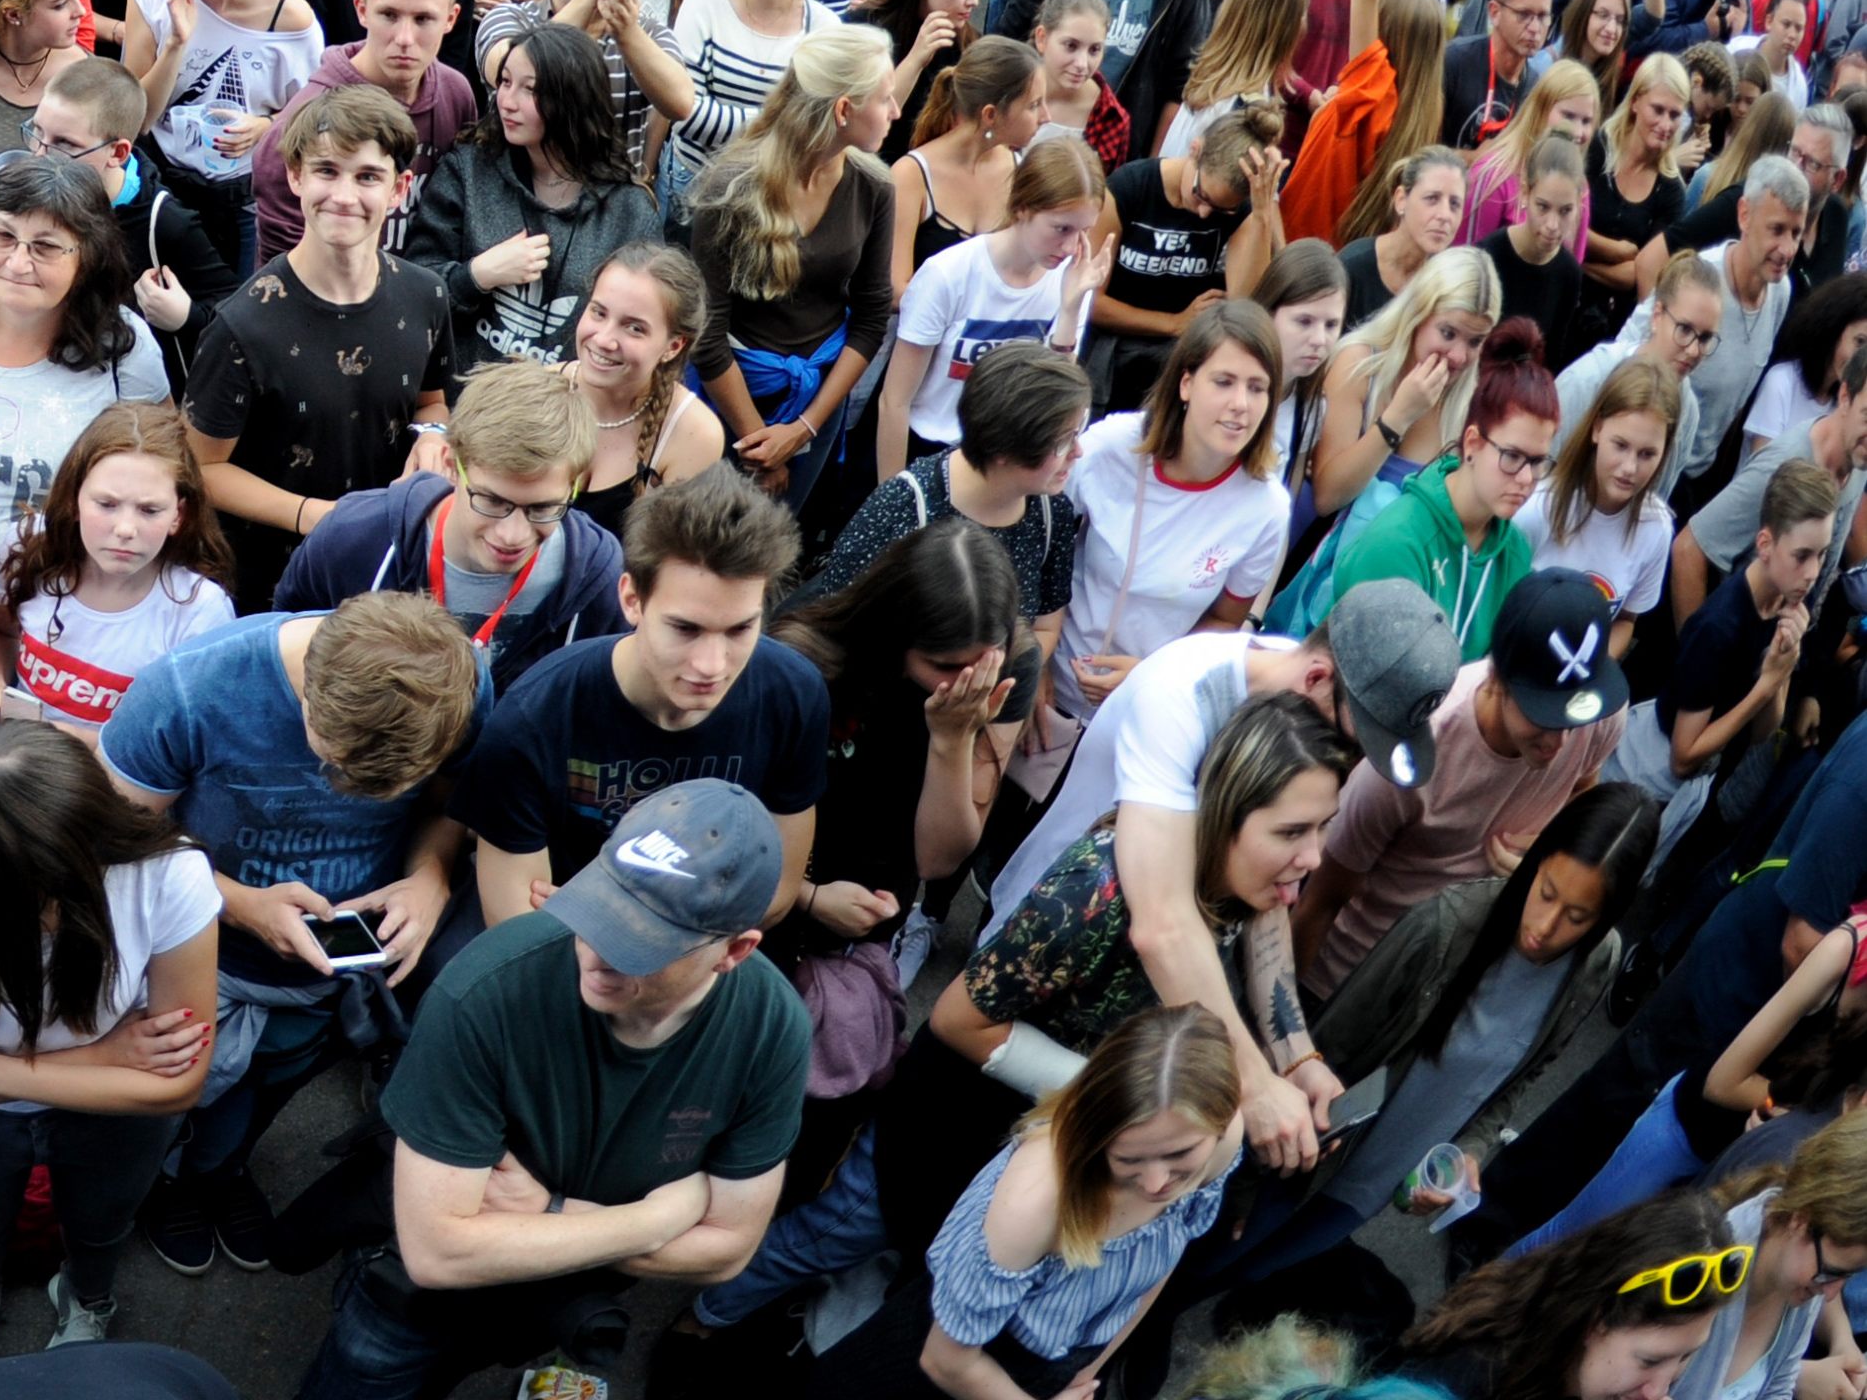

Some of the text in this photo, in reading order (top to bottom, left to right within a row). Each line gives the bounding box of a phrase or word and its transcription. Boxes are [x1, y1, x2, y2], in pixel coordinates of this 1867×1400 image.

[1154, 232, 1191, 253] YES,
[476, 318, 564, 367] adidas
[19, 644, 121, 709] uprem
[634, 829, 690, 866] NIKE
